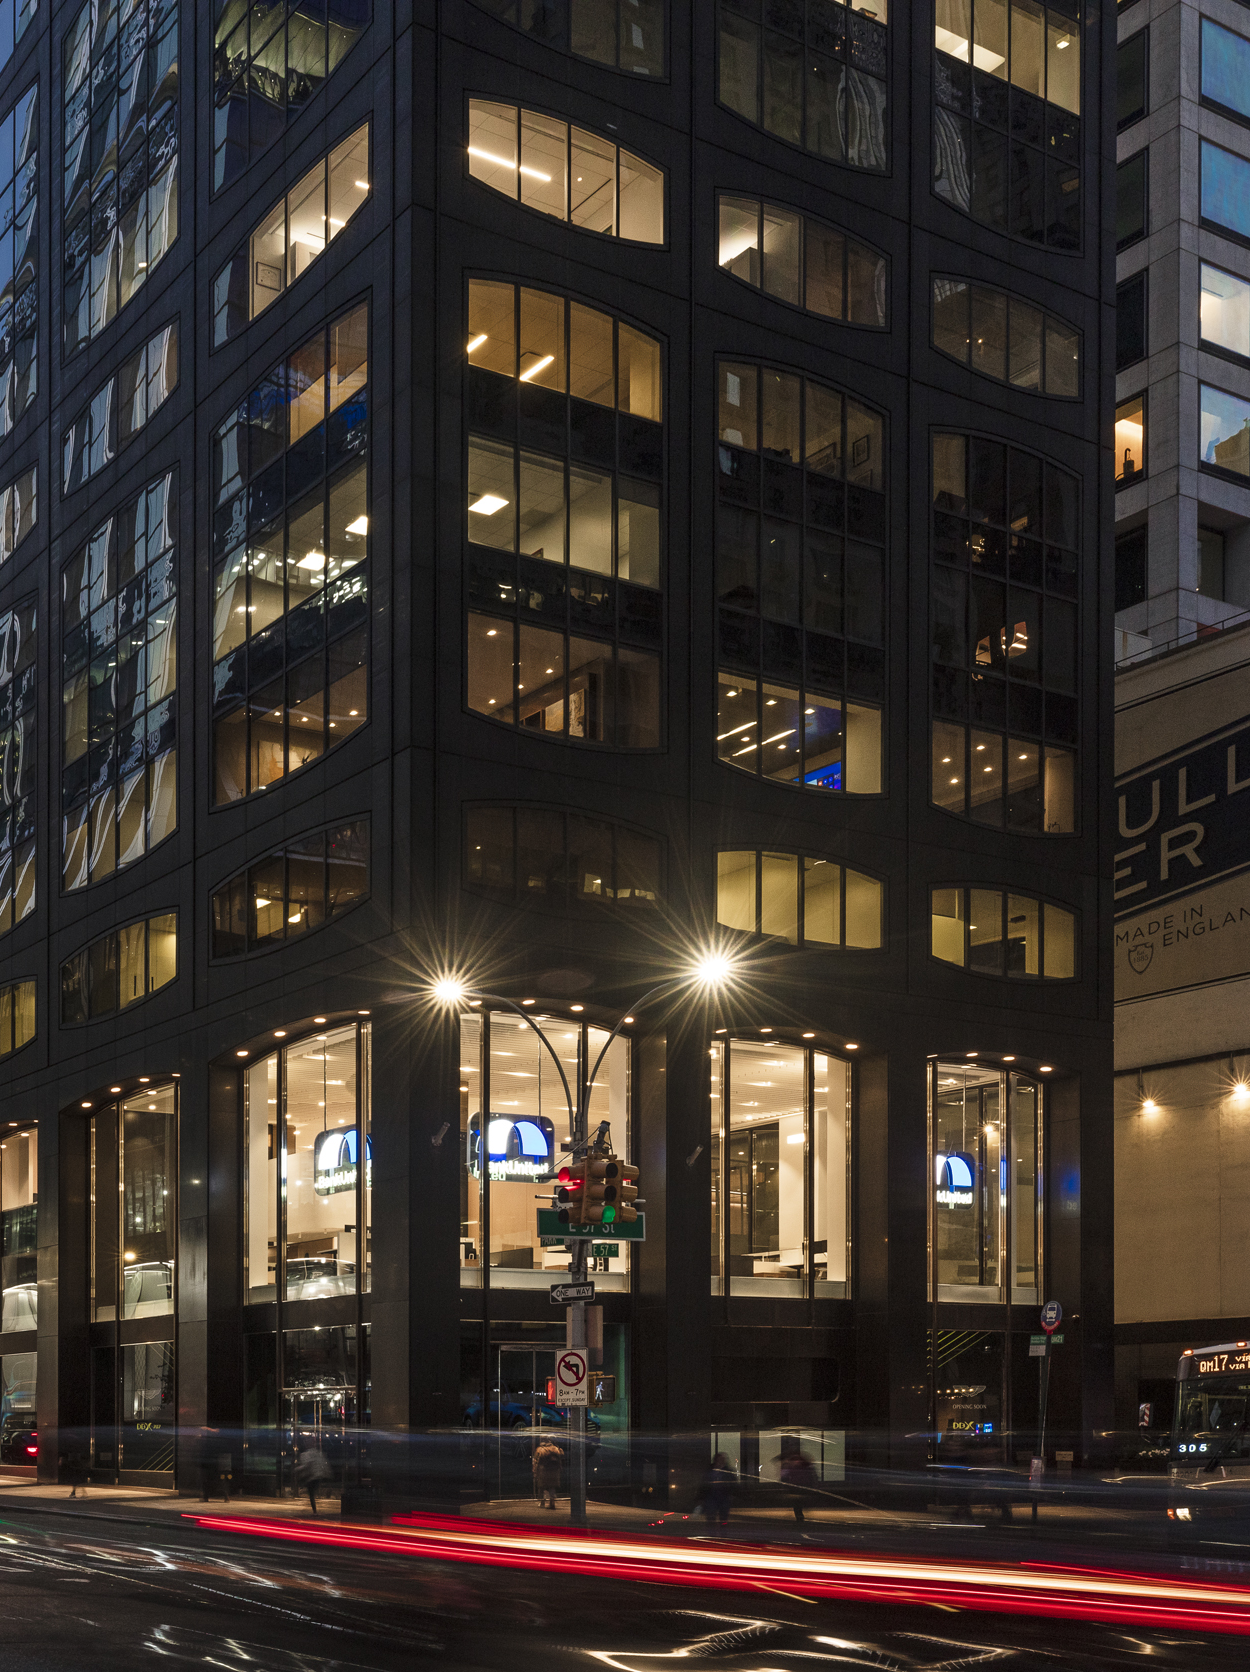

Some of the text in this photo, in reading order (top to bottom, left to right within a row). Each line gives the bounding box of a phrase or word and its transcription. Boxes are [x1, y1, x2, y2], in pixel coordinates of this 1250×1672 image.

[1116, 904, 1203, 947] MADE IN
[593, 1244, 597, 1256] E
[600, 1244, 609, 1256] 57
[556, 1287, 590, 1298] ONE WAY
[1199, 1354, 1228, 1373] QM17
[952, 1421, 975, 1430] DBX
[1178, 1443, 1208, 1453] 305
